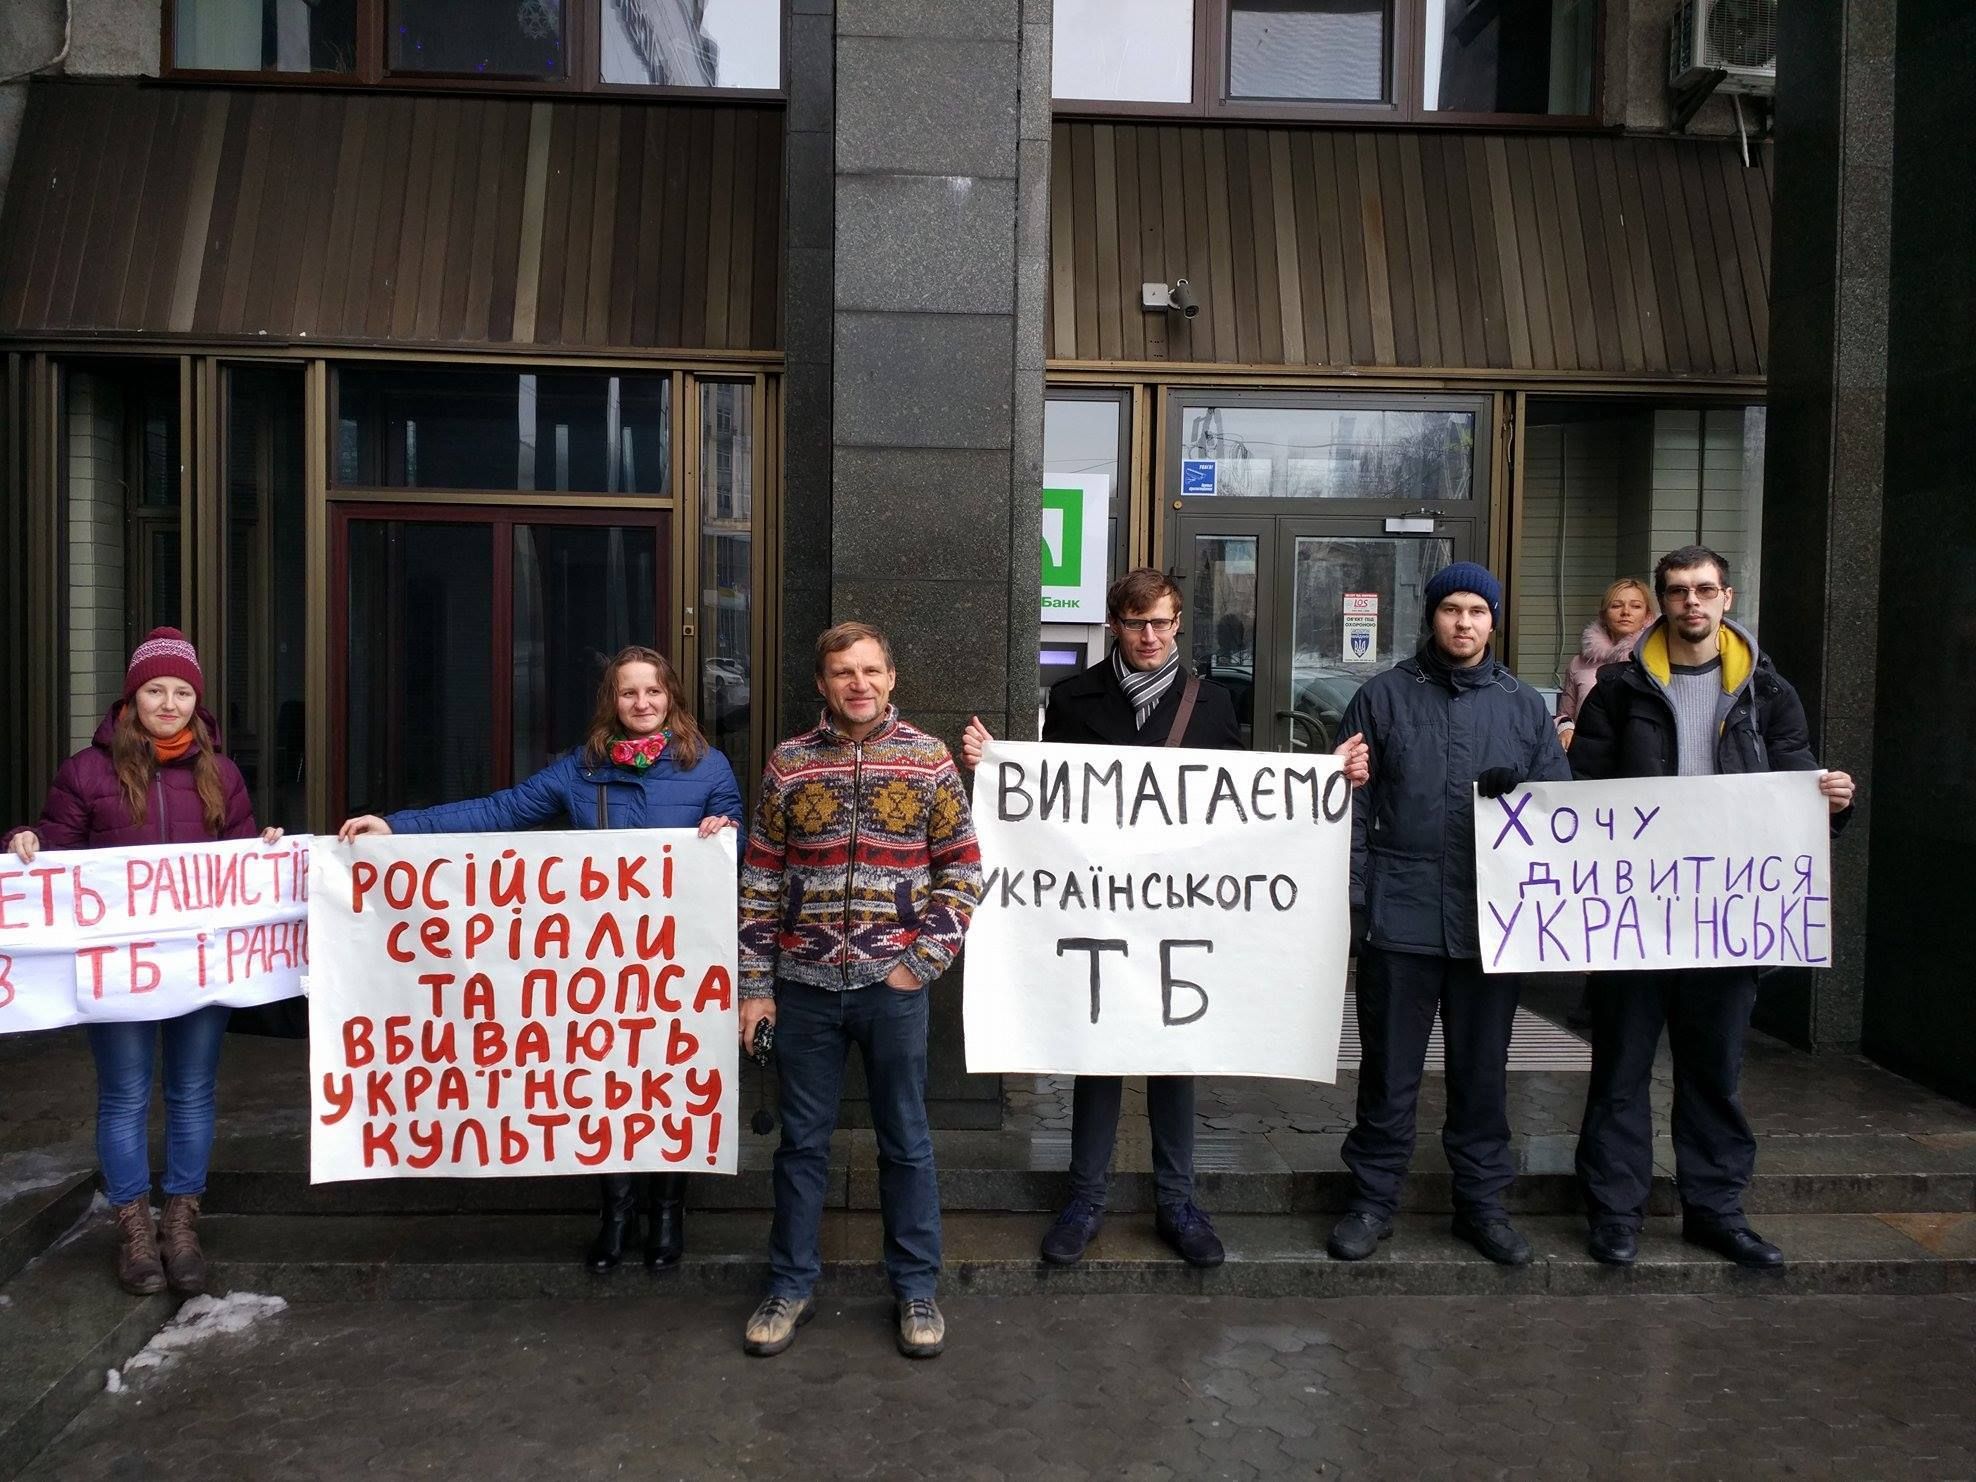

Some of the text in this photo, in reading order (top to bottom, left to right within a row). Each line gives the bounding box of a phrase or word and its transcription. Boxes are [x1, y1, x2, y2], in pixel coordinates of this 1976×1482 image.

[1041, 596, 1080, 608] Банк
[998, 759, 1352, 828] ВИМАГАЄМО
[351, 844, 673, 914] РОСІЙСЬКІ
[976, 865, 1298, 912] УКРАЇНСЬКОГО
[1519, 854, 1813, 899] ДИВИТИСЯ
[1488, 894, 1829, 967] УКРАЇНСЬКЕ
[75, 941, 161, 1000] ТБ
[418, 963, 732, 1021] ТА ПОПСА
[1056, 937, 1214, 1027] ТБ
[342, 1015, 700, 1069] ВБИВАЮТЬ
[320, 1066, 723, 1125] УКРАЇНСЬКУ
[362, 1112, 722, 1168] КУЛЬТУРУ!
